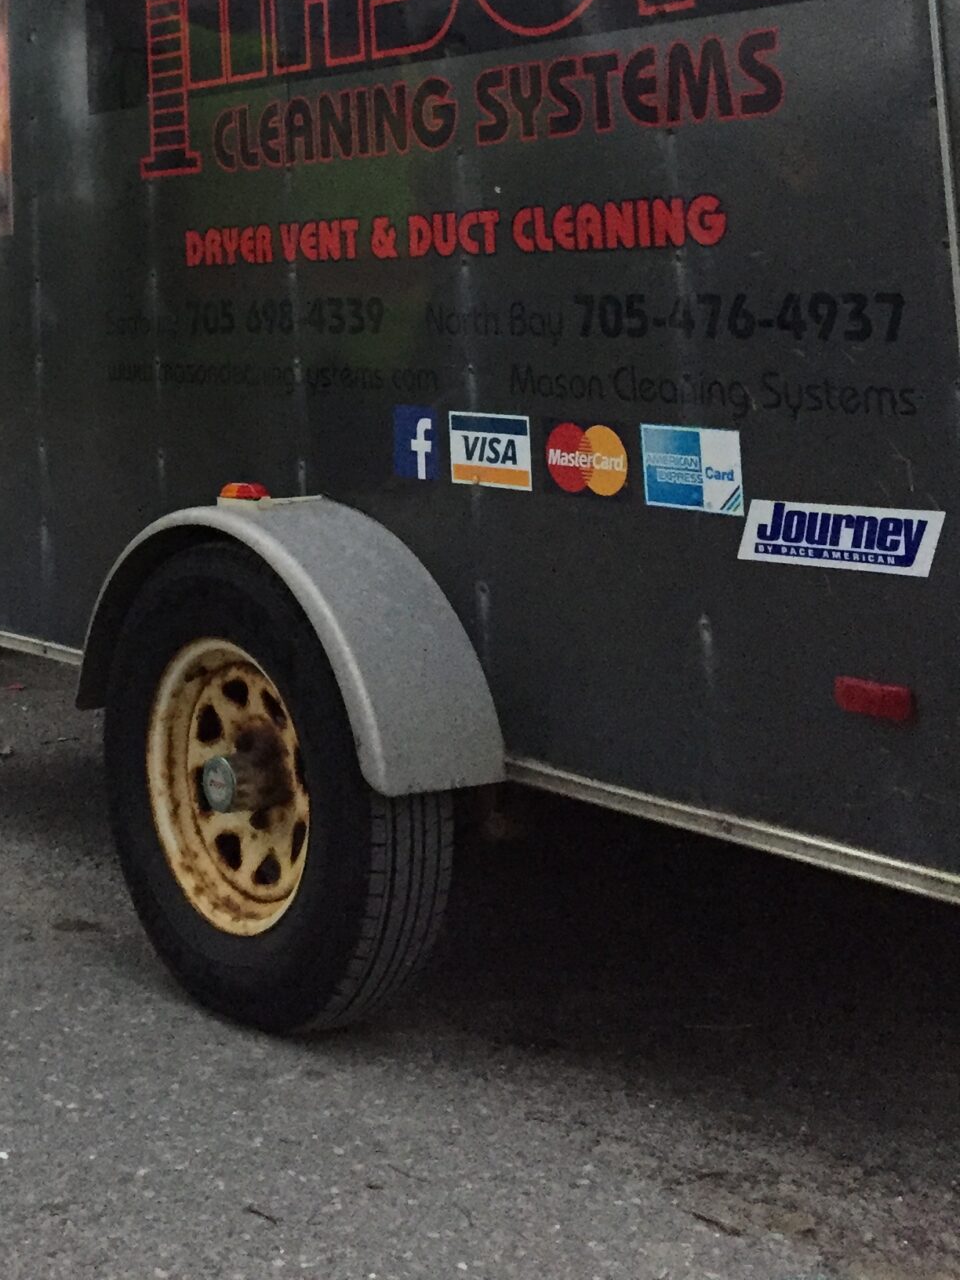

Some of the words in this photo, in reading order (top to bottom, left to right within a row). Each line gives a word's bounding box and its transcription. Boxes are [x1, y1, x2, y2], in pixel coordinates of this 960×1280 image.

[212, 75, 458, 173] CLEANING
[475, 26, 784, 146] SYSTEMS
[184, 223, 274, 268] DRYER
[279, 218, 359, 263] VENT
[370, 215, 399, 260] &
[407, 210, 499, 257] DUCT
[512, 194, 727, 253] CLEANING
[508, 299, 564, 347] Bay
[572, 291, 907, 343] 705-476-4937
[509, 363, 607, 401] Mason
[761, 370, 919, 419] Systems
[460, 434, 519, 465] VISA
[548, 448, 626, 472] MasterCard
[645, 452, 700, 469] AMERICAN
[657, 469, 704, 485] EXPRESS
[705, 466, 735, 482] Card
[756, 502, 929, 567] Journey
[757, 544, 773, 554] BY
[781, 546, 815, 558] PACE
[822, 550, 897, 566] AMERICAN
